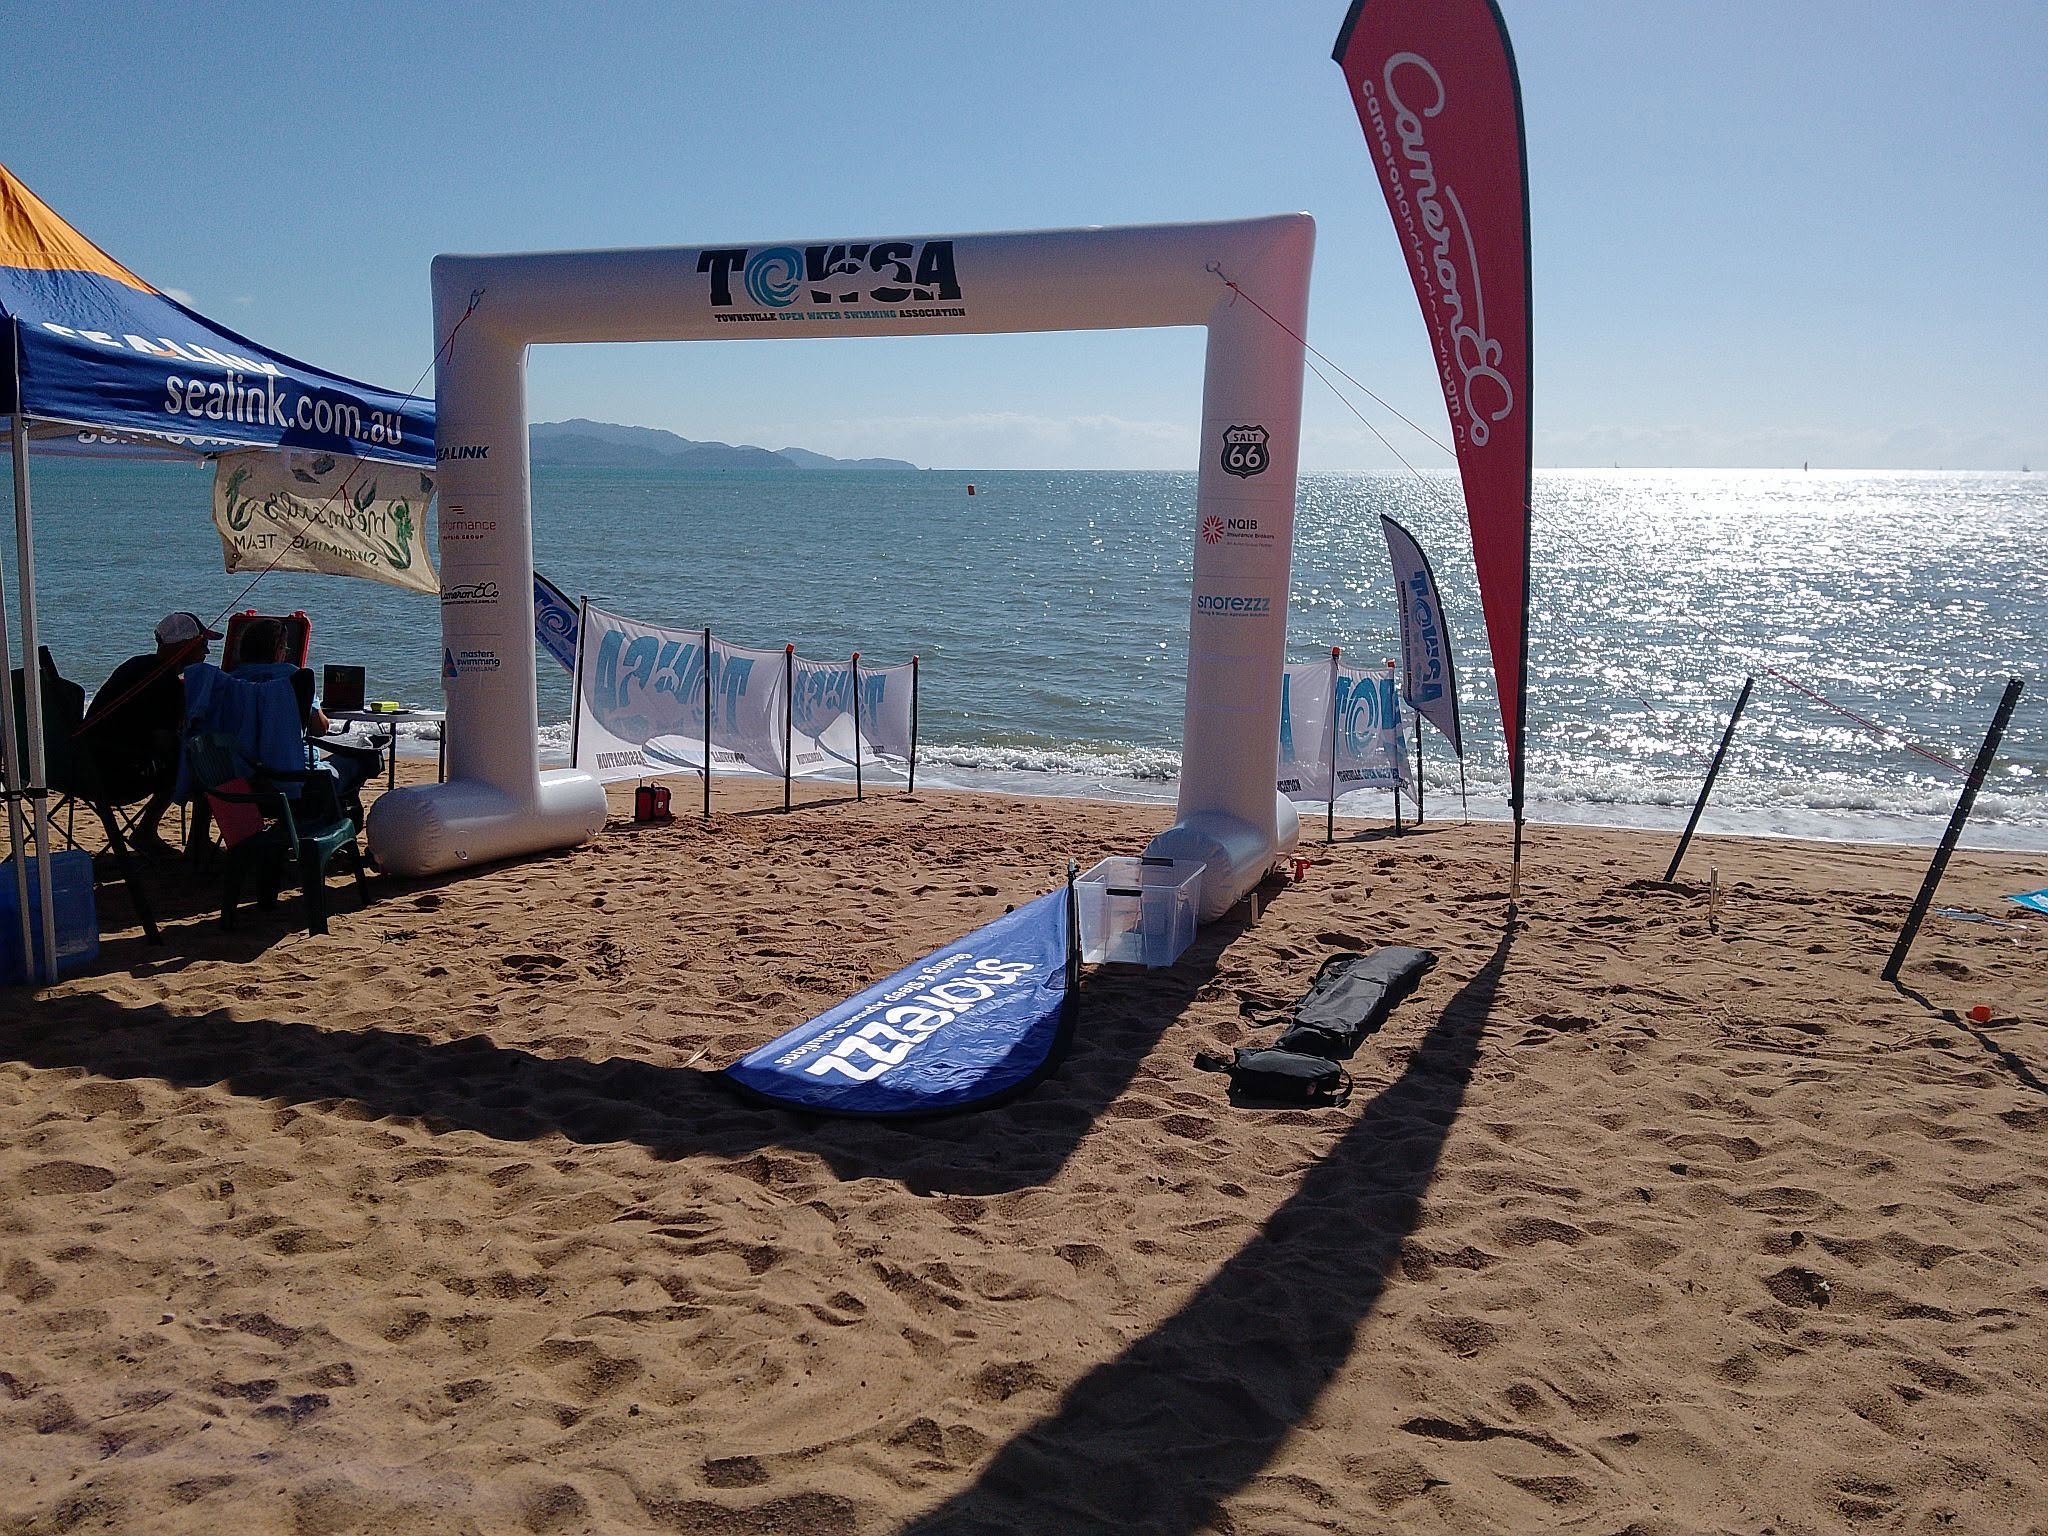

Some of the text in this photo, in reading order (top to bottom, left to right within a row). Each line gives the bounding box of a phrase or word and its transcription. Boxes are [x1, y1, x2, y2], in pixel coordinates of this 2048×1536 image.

[696, 240, 962, 308] TOWSA
[714, 308, 966, 322] TOWNSVILLE OPEN WATER SWIMMING ASSOCIATION
[164, 369, 402, 446] sealink.com.au
[1233, 433, 1259, 442] SALT
[1229, 445, 1261, 468] 66
[1227, 518, 1258, 530] NQIB
[1197, 595, 1271, 611] snorezzz
[1408, 570, 1443, 703] TOWSA
[460, 650, 495, 658] masters
[457, 658, 501, 667] swimming
[882, 980, 927, 1003] Sleep
